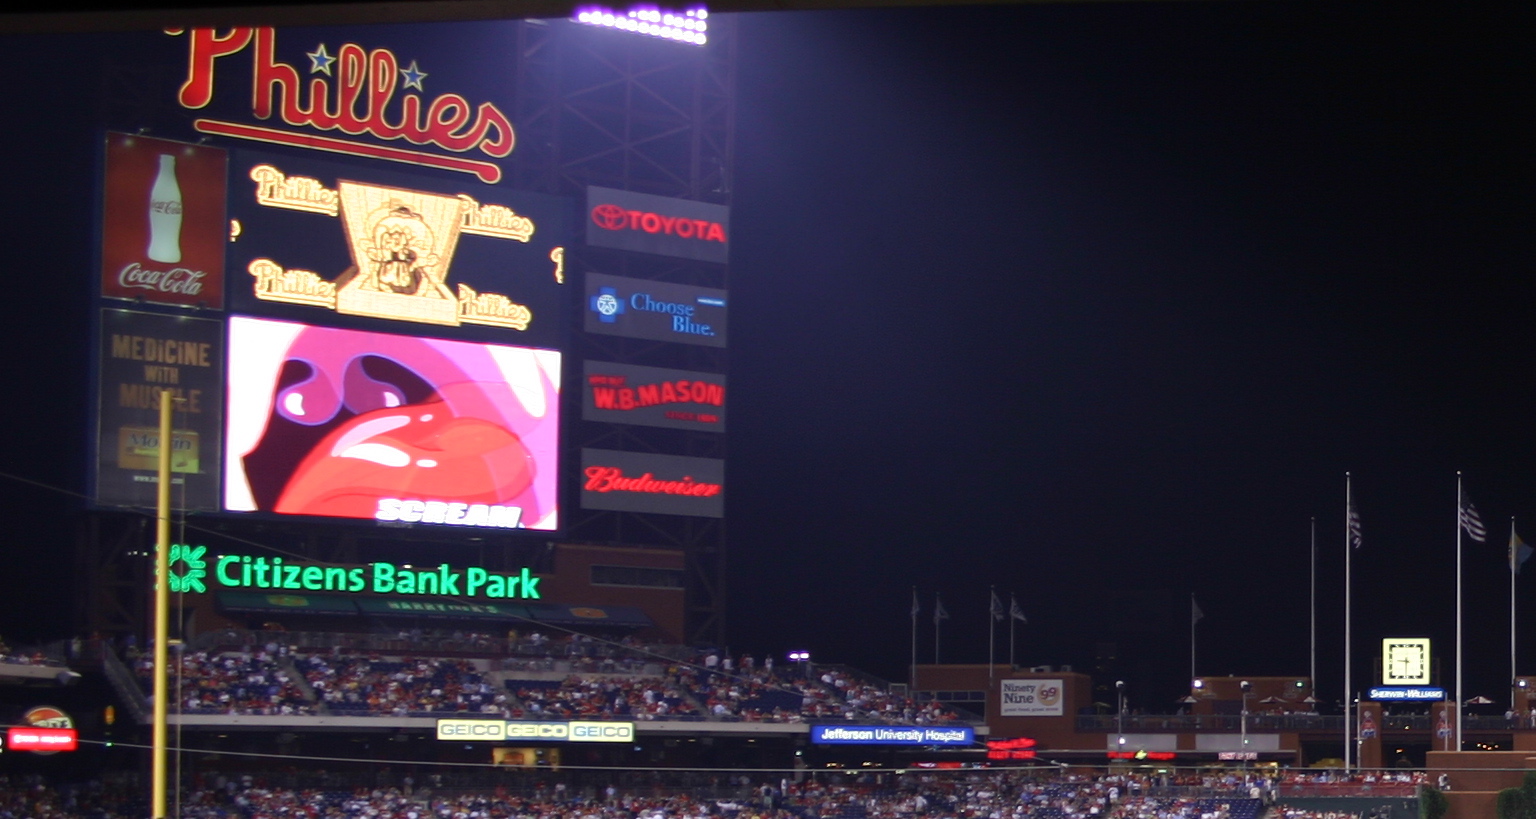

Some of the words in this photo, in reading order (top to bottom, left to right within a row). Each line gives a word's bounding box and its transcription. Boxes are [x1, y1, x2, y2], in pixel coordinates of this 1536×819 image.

[250, 164, 339, 210] Phillie
[626, 210, 727, 243] TOYOTA
[119, 263, 207, 295] Coca-Cola
[248, 258, 336, 305] Phillie
[630, 293, 695, 316] Choose
[672, 315, 715, 336] Blue.
[129, 433, 191, 450] Moin
[584, 466, 722, 497] Budweiser
[216, 555, 365, 592] Citizens
[373, 562, 460, 596] Bank
[467, 567, 540, 599] Park
[1004, 684, 1035, 693] Ninety
[1004, 692, 1034, 704] Nine
[1041, 686, 1057, 700] 99
[440, 724, 501, 736] GEICO
[507, 724, 568, 737] GEICO
[574, 726, 631, 738] GEICO
[821, 728, 872, 740] Jefferson
[875, 728, 924, 743] University
[925, 730, 965, 743] Hospital
